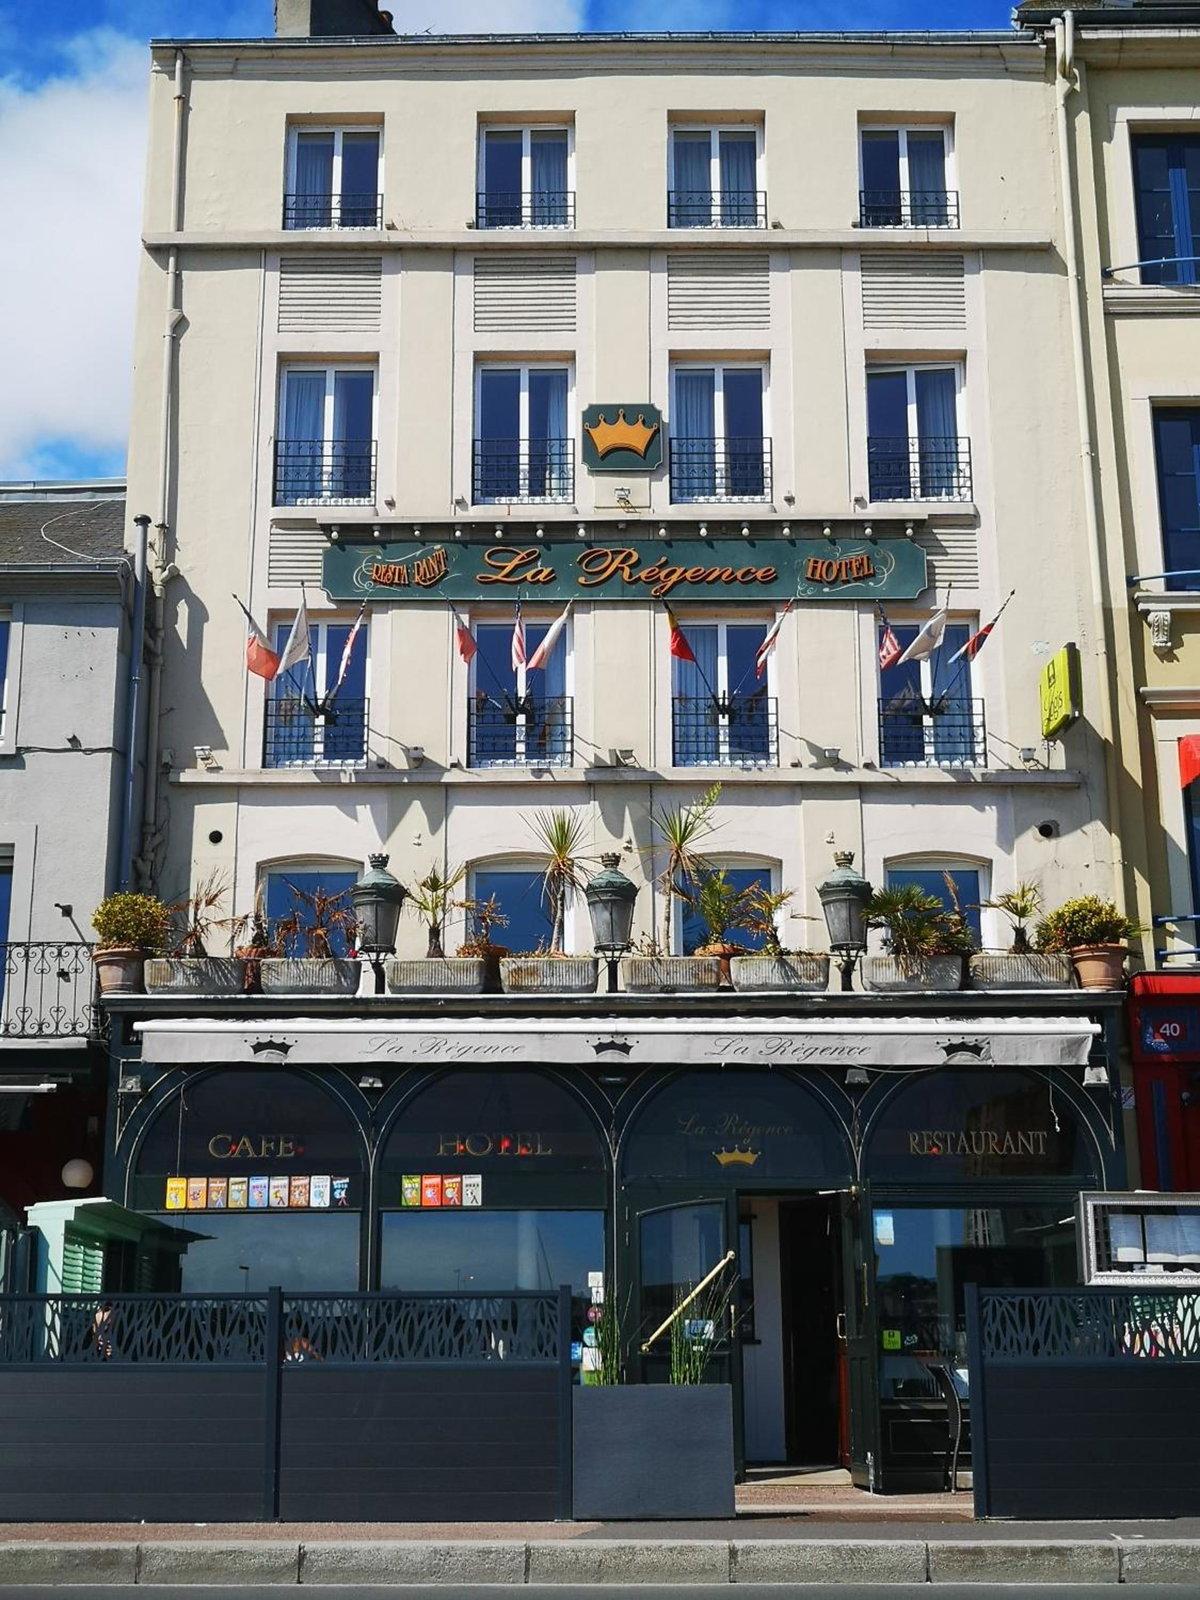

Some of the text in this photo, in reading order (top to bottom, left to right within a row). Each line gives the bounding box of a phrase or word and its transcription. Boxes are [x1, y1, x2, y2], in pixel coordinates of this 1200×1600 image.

[476, 546, 778, 597] La Régence
[806, 554, 875, 584] HOTEL
[1159, 1023, 1180, 1036] 40
[359, 1036, 526, 1060] La Régence
[704, 1036, 871, 1062] La Régence
[677, 1114, 706, 1136] La
[208, 1134, 297, 1159] CAFE
[436, 1132, 552, 1157] HOTEL
[908, 1130, 1048, 1155] RESTAURANT
